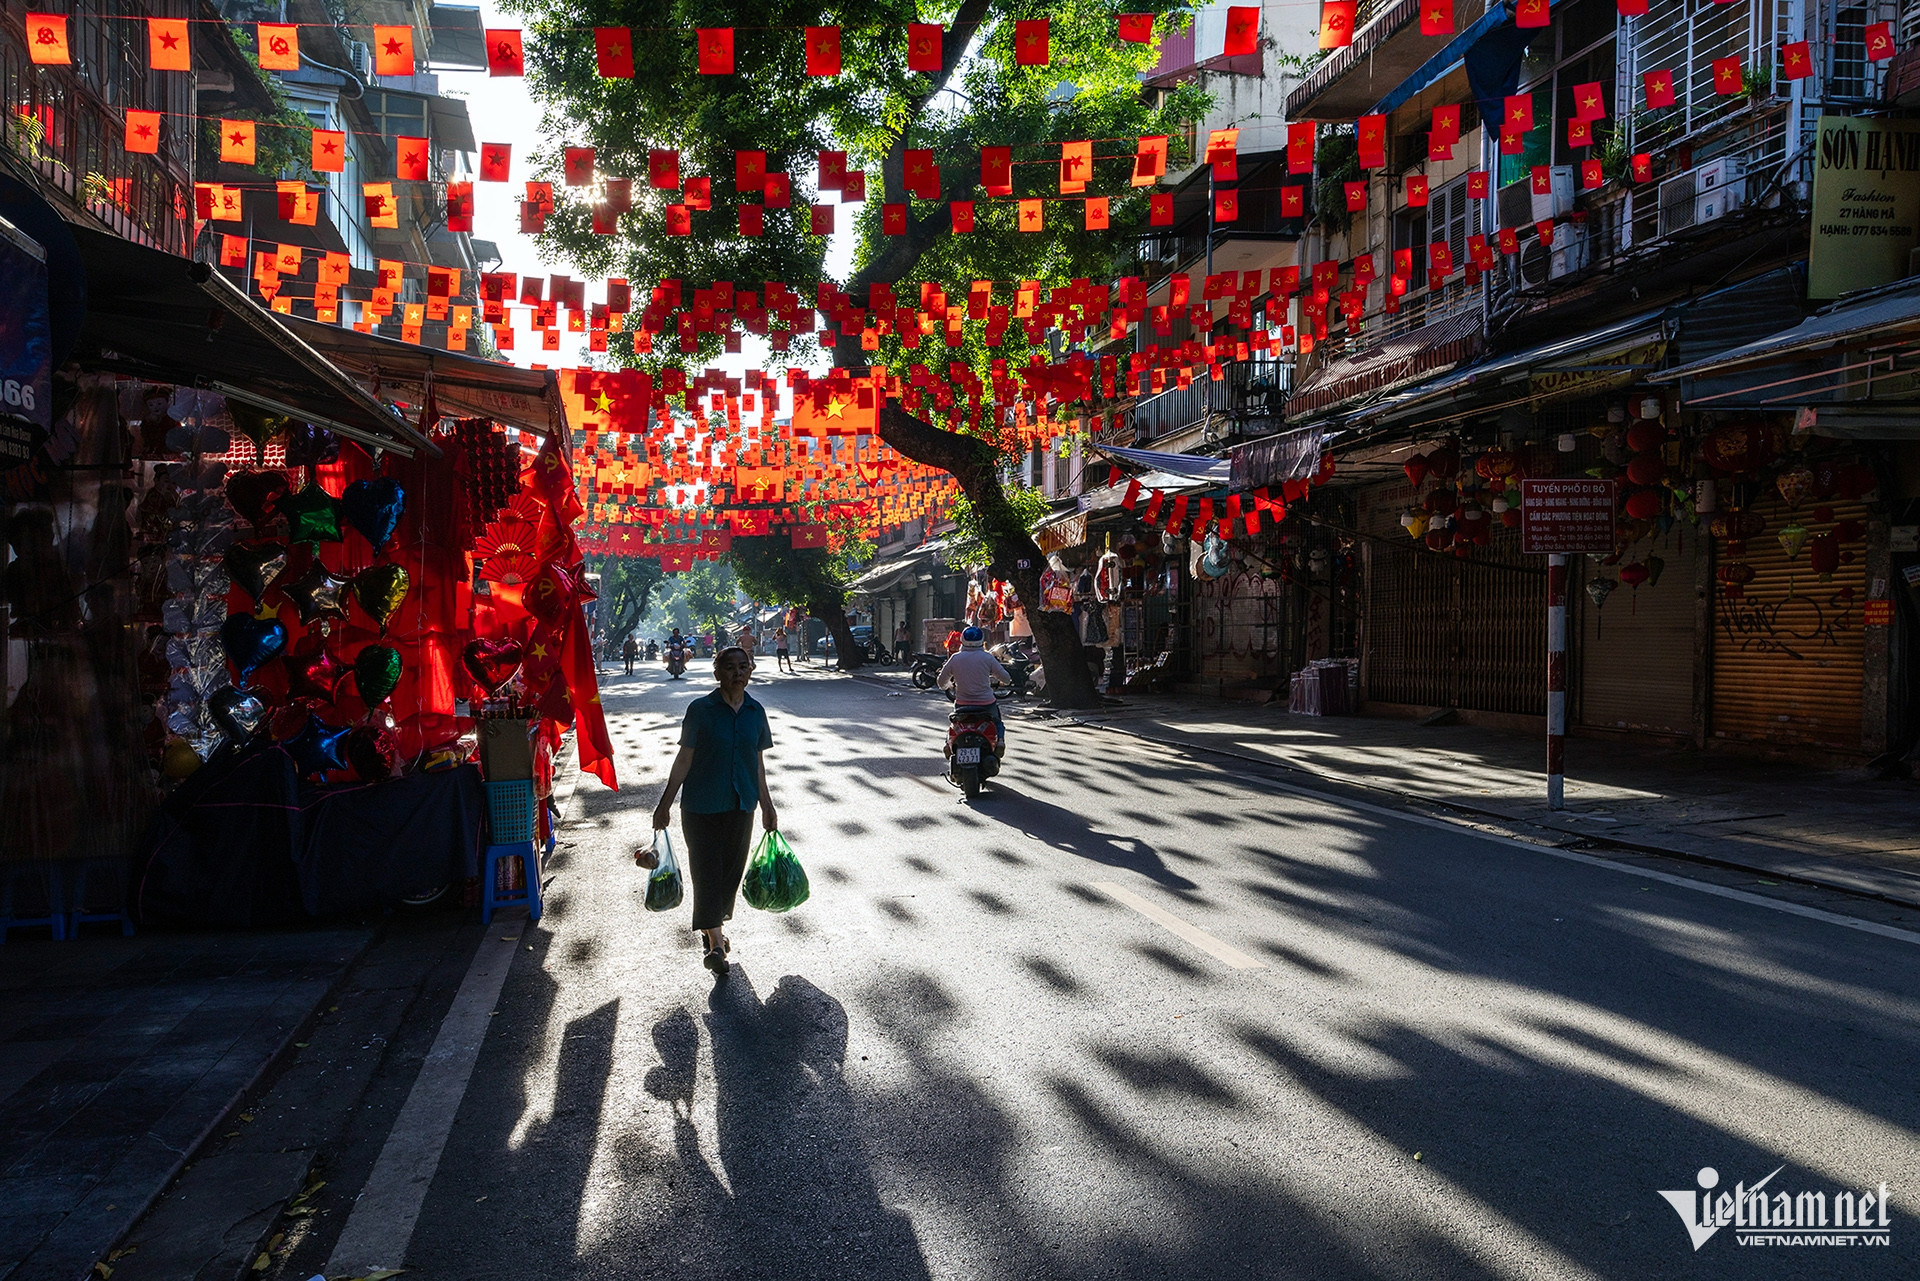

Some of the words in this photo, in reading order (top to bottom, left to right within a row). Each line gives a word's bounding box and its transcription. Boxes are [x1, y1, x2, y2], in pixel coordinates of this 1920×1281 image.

[1821, 124, 1861, 170] SƠN
[1841, 188, 1896, 203] Fashion
[1839, 208, 1851, 219] 27
[1853, 206, 1879, 220] HÀNG
[1880, 206, 1895, 219] MÃ
[1820, 225, 1850, 238] HẠNH:
[1852, 226, 1868, 237] 077
[1532, 482, 1561, 494] TUYẾN
[1562, 482, 1581, 493] PHỐ
[1582, 485, 1591, 493] ĐI
[1593, 483, 1606, 495] BỘ
